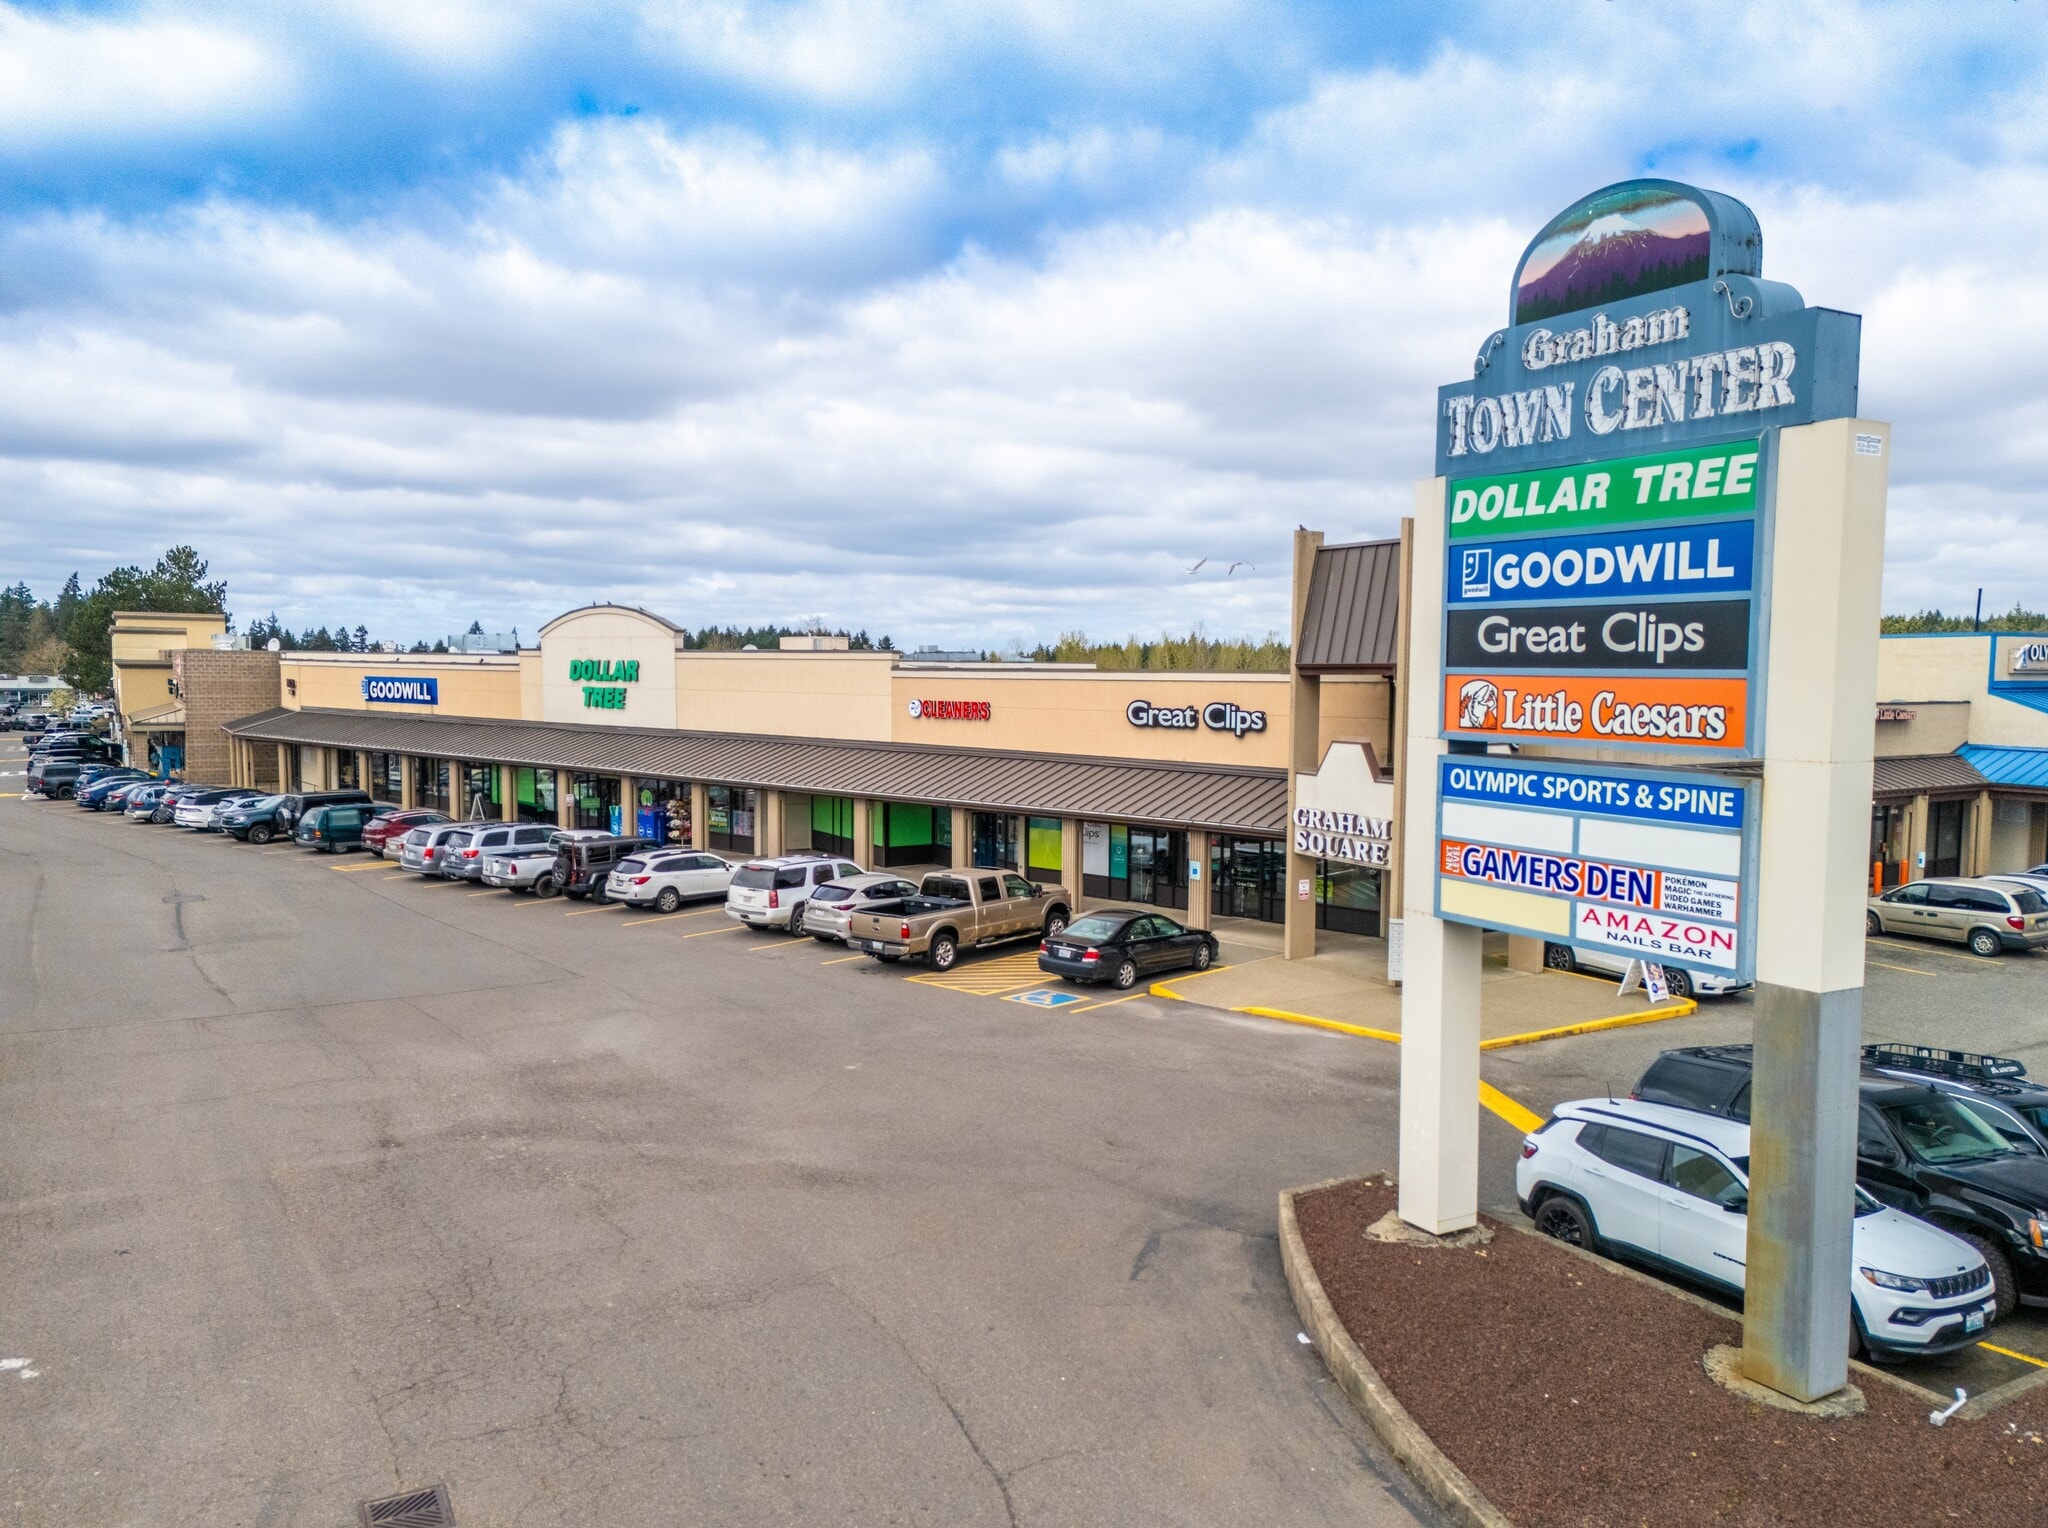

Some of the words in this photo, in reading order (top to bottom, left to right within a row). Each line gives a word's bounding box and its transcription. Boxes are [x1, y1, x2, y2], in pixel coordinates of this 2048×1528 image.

[1522, 305, 1690, 370] Graham
[1444, 382, 1574, 457] TOWN
[1584, 341, 1797, 434] CENTER
[1451, 472, 1610, 524] DOLLAR
[1632, 453, 1758, 505] TREE
[1494, 538, 1734, 590] GOODWILL
[1477, 615, 1586, 654] Great
[1602, 612, 1705, 664] Clips
[569, 659, 639, 683] DOLLAR
[370, 681, 432, 701] GOODWILL
[582, 686, 627, 710] TREE
[922, 700, 990, 720] CLEANERS
[1127, 700, 1198, 729] Great
[1203, 703, 1267, 737] Clips
[1502, 690, 1583, 734] Little
[1591, 690, 1727, 741] Caesars
[1450, 768, 1537, 798] OLYMPIC
[1542, 776, 1629, 807] SPORTS
[1635, 785, 1654, 808] &
[1659, 787, 1735, 818] SPINE
[1293, 807, 1392, 841] GRAHAM
[1295, 830, 1390, 865] SQUARE
[1452, 846, 1460, 872] LEVEL
[1462, 846, 1581, 893] GAMERS
[1586, 866, 1653, 905] DEN
[1664, 885, 1692, 895] MAGIC
[1704, 891, 1735, 901] GATHERING
[1664, 893, 1689, 904] VIDEO
[1690, 897, 1722, 909] GAMES
[1664, 902, 1722, 918] WARHAMMER
[1582, 908, 1733, 951] AMAZON
[1606, 931, 1662, 949] NAILS
[1669, 943, 1712, 959] BAR
